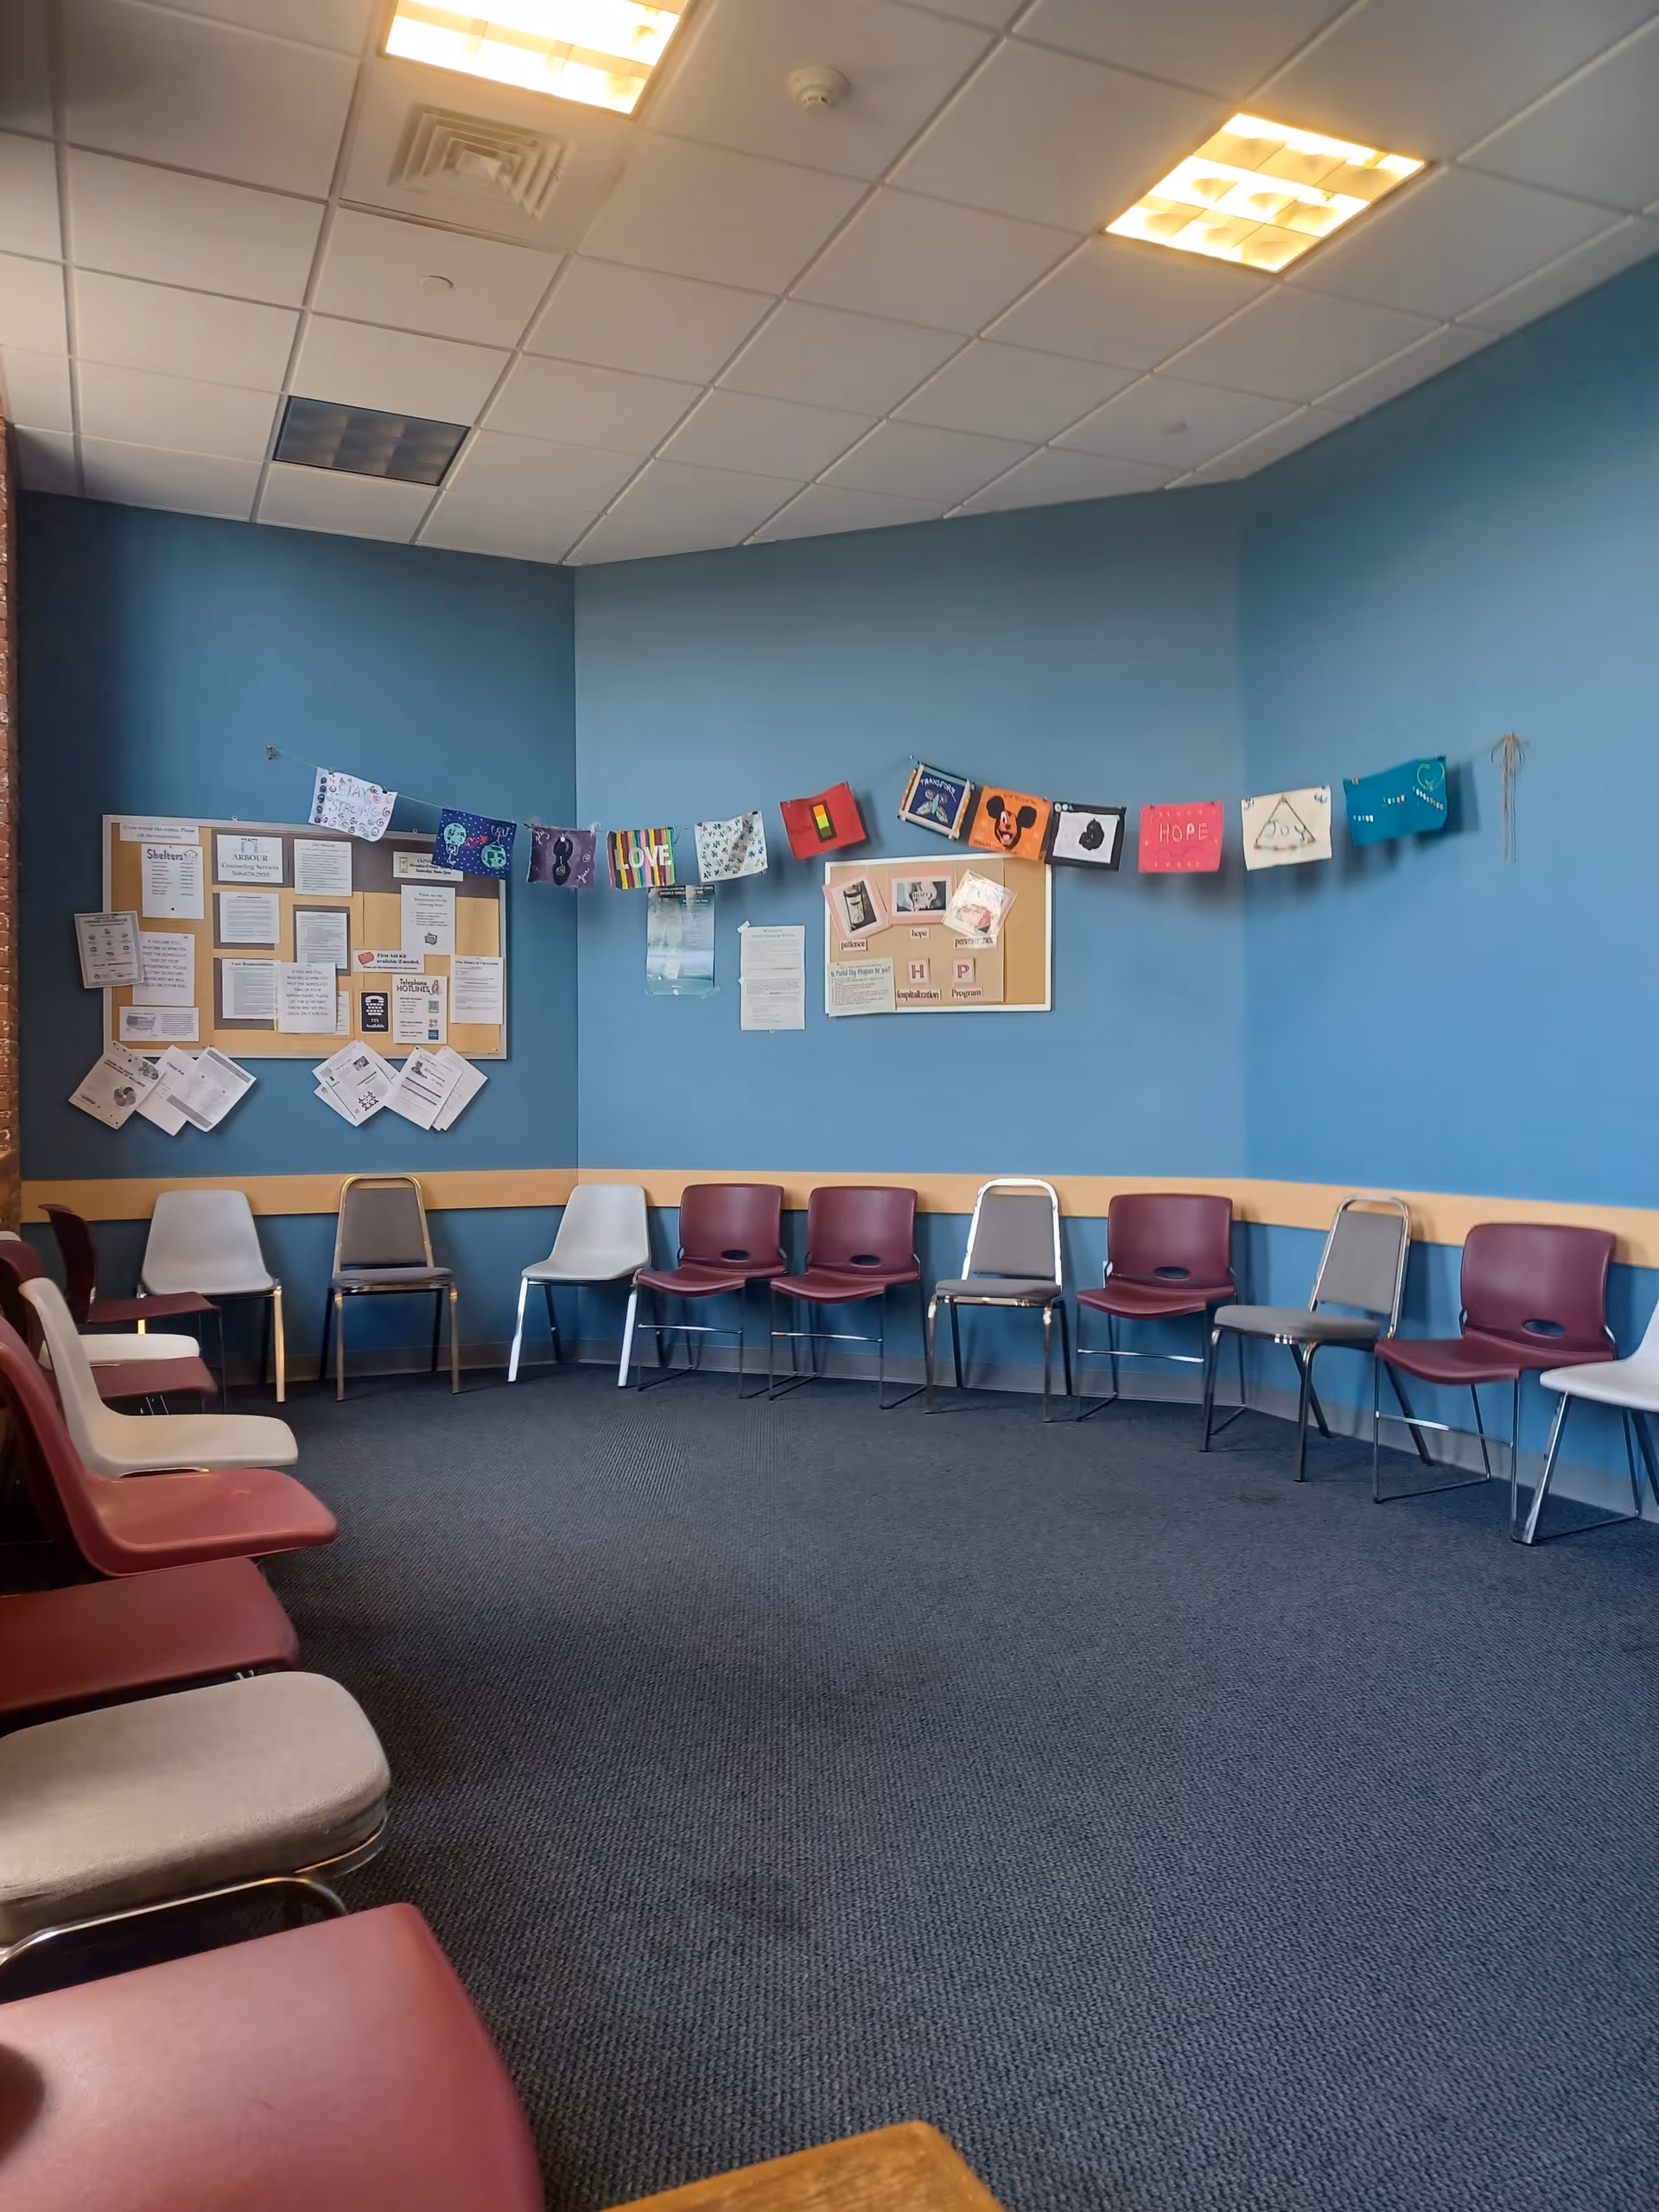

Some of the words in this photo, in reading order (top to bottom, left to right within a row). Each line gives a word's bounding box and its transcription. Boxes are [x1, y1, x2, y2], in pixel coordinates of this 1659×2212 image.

[339, 783, 371, 798] STAY
[920, 778, 957, 803] TRANSFORM
[332, 799, 381, 817] STRONG
[1159, 822, 1208, 843] HOPE
[147, 849, 183, 861] Shelters
[614, 843, 672, 871] LOVE
[911, 930, 927, 938] hope
[841, 941, 866, 950] patience
[911, 964, 925, 979] H
[957, 964, 969, 979] P
[399, 978, 427, 987] Telephone
[951, 988, 982, 999] Program
